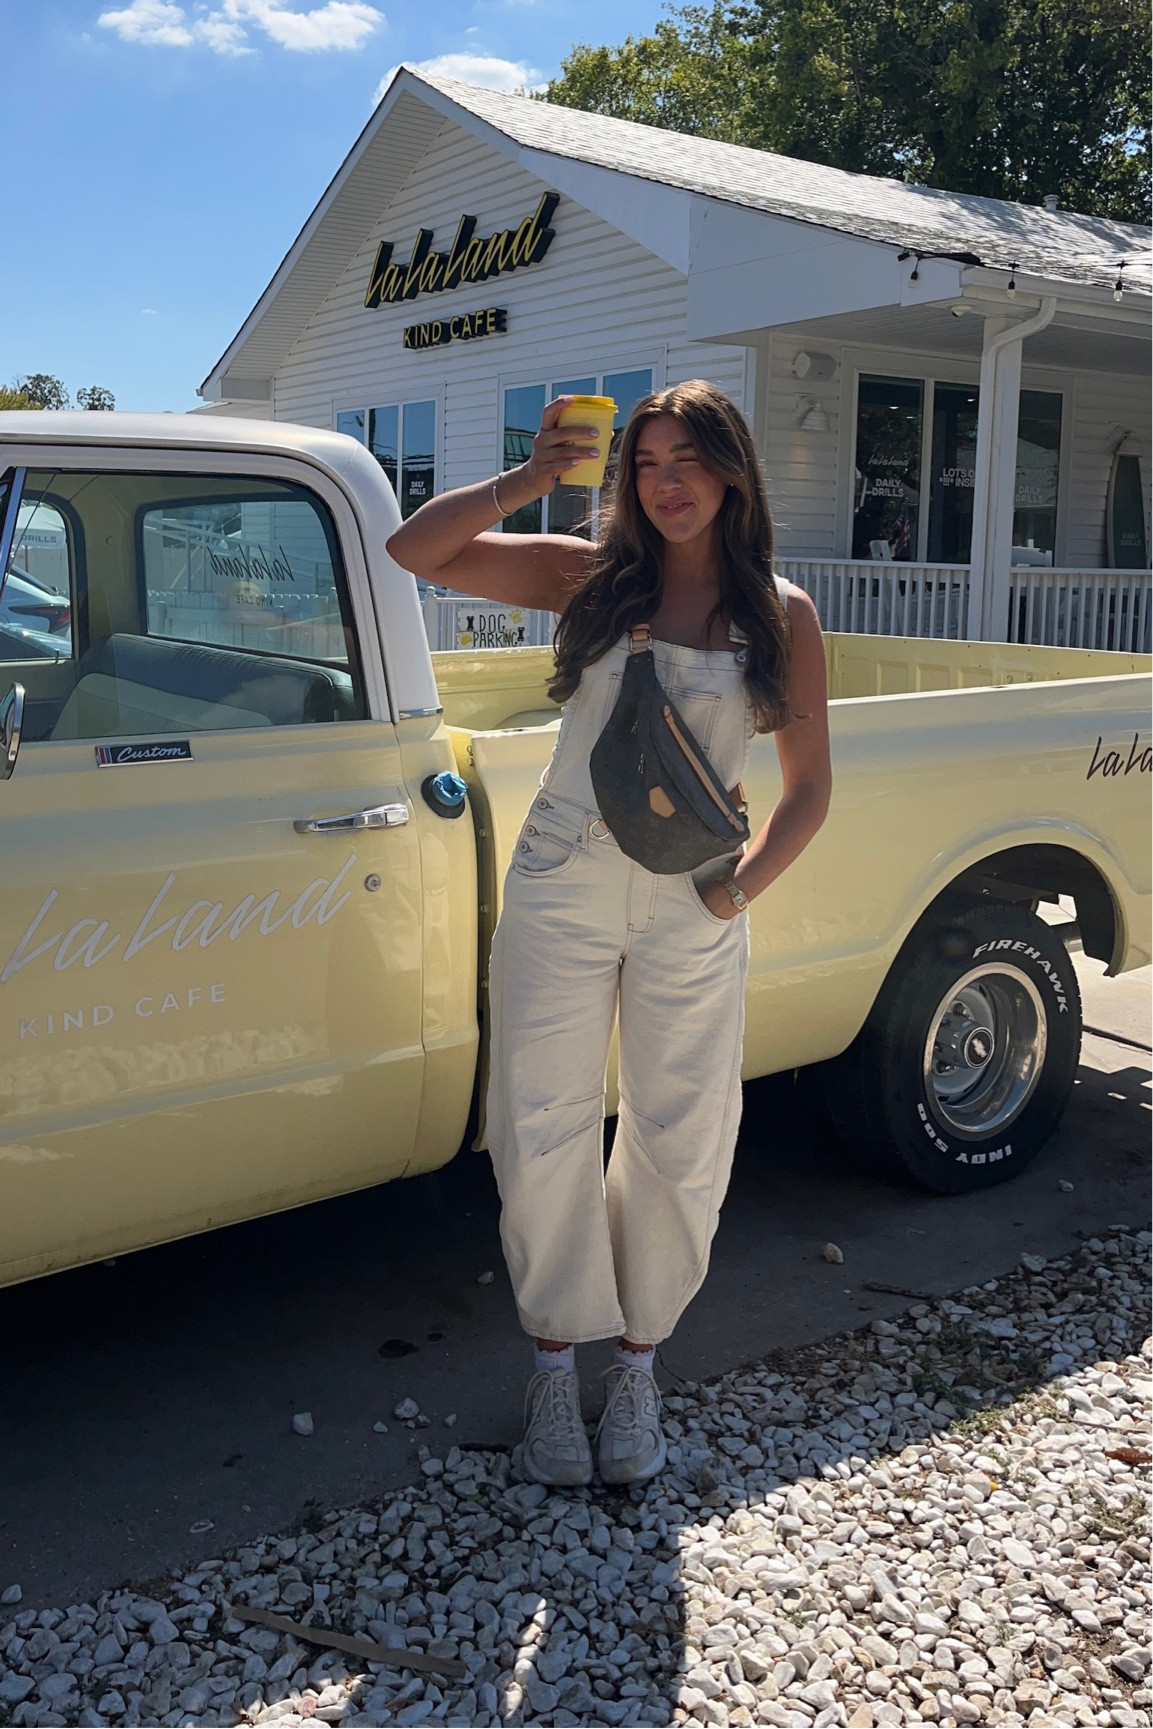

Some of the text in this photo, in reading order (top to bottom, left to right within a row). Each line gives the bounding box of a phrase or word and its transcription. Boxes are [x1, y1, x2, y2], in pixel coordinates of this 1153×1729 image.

[403, 308, 500, 348] KIND CAFE
[943, 468, 967, 478] LOTS
[409, 488, 426, 496] DRILLS
[876, 479, 901, 488] DAILY
[871, 488, 904, 497] DRILLS
[22, 534, 57, 543] DRILLS
[479, 613, 507, 633] DOG
[472, 631, 518, 648] PARKNG
[117, 746, 187, 763] Custom
[972, 939, 1069, 1013] FIREHAWK
[18, 982, 227, 1040] KIND CAFE
[917, 1103, 1013, 1165] INDY 500
